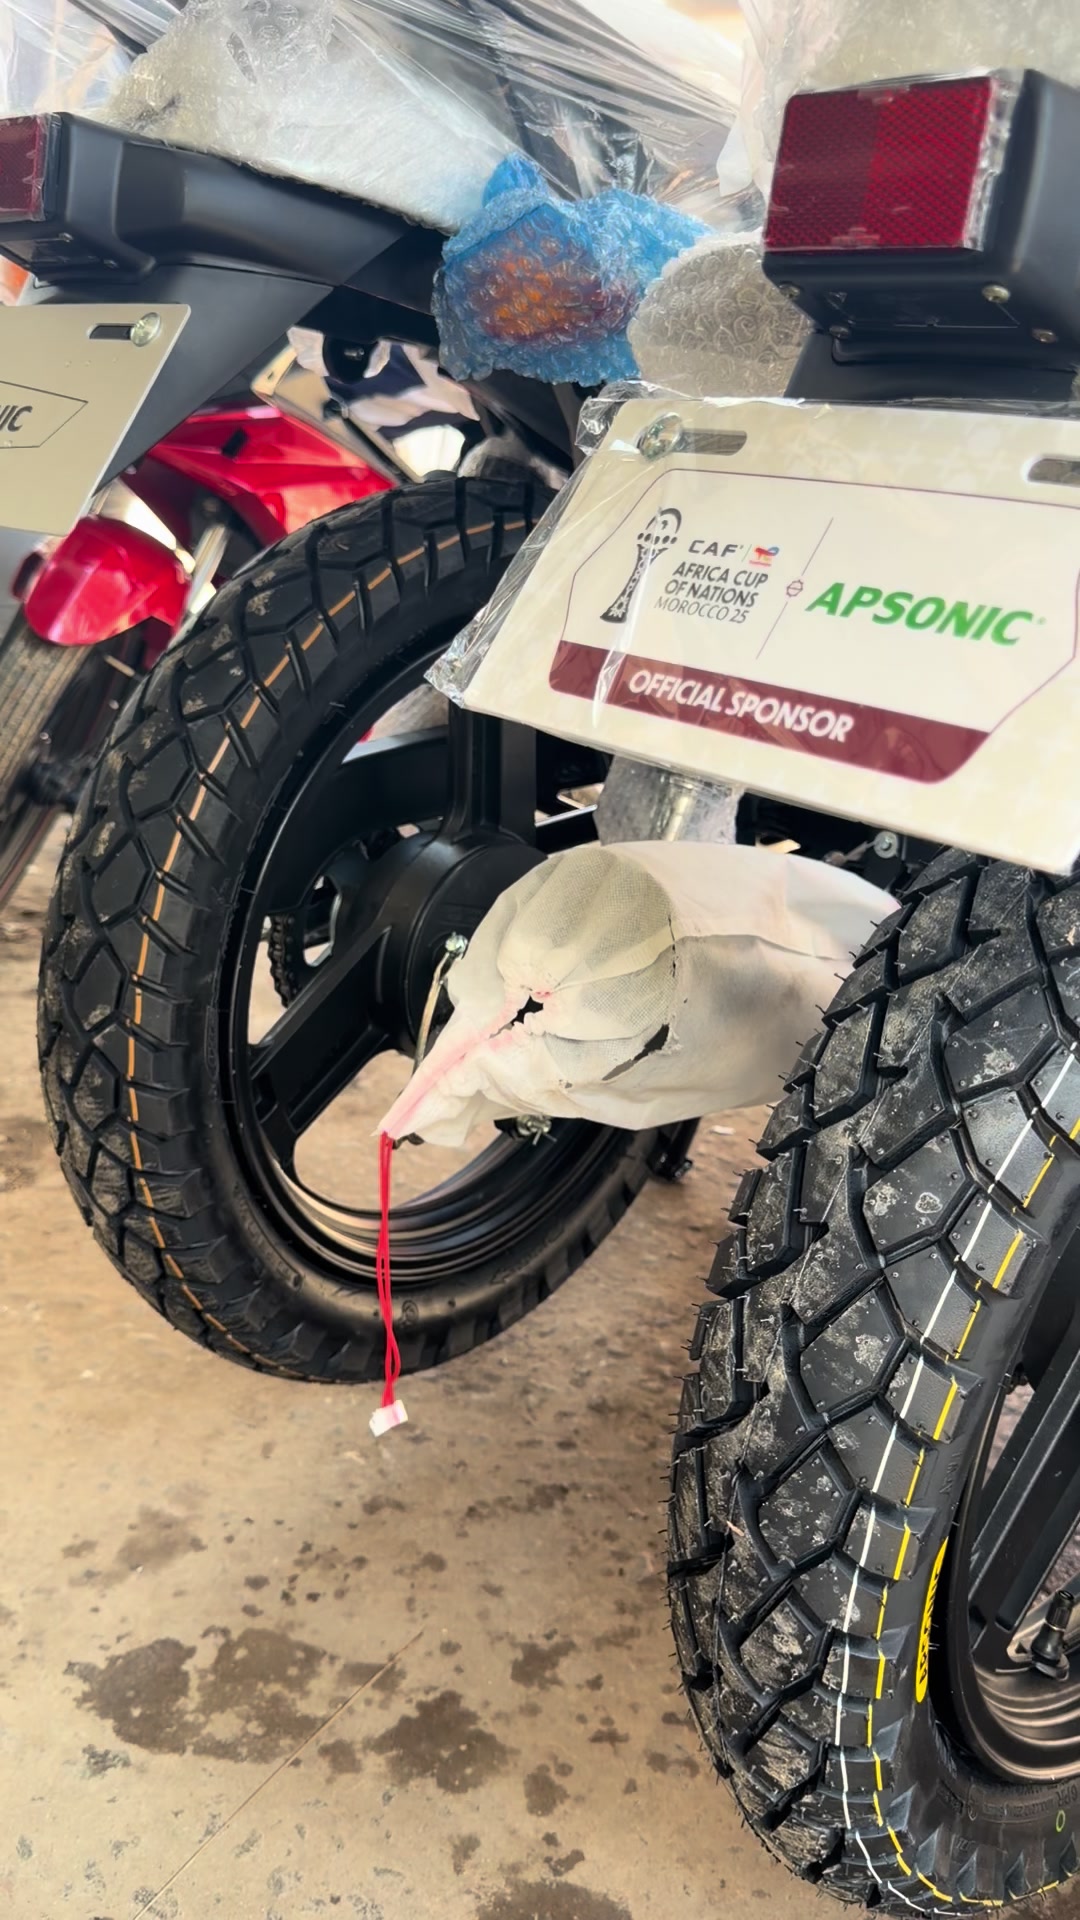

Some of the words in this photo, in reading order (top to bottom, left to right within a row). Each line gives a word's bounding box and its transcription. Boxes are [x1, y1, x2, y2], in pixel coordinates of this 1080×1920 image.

[688, 539, 739, 557] CAF
[672, 561, 730, 583] AFRICA
[733, 570, 769, 589] CUP
[664, 579, 688, 596] OF
[686, 582, 759, 608] NATIONS
[654, 596, 730, 621] MOROCCO
[729, 608, 750, 624] 25
[804, 582, 1034, 646] APSONIC
[628, 669, 726, 713] OFFICIAL
[725, 690, 855, 743] SPONSOR
